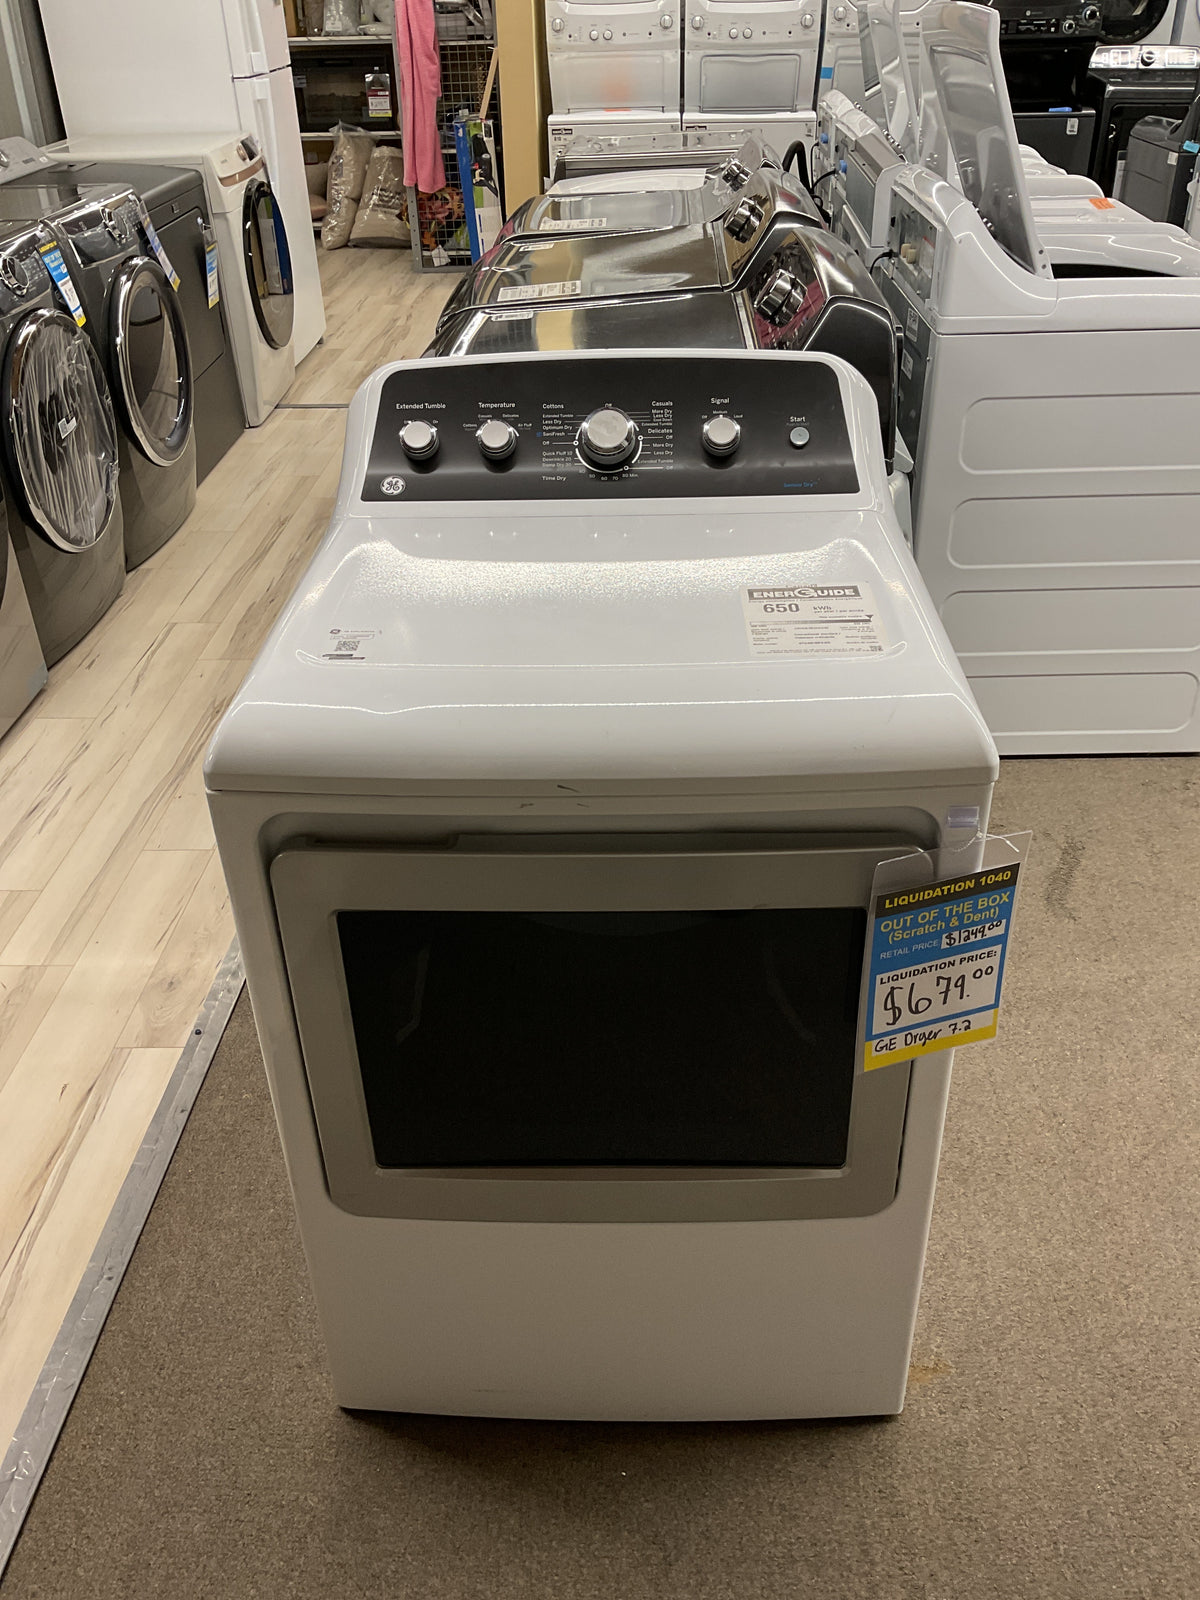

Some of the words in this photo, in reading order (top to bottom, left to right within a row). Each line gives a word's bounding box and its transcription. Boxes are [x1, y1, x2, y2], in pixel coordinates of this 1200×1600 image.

[710, 397, 730, 405] Signal
[789, 415, 806, 423] Start
[753, 587, 856, 599] ENERGUIDE
[763, 602, 801, 614] 650
[884, 879, 976, 909] LIQUIDATION
[979, 870, 1012, 886] 1040
[880, 914, 914, 933] OUT
[917, 908, 940, 924] OF
[943, 900, 974, 918] THE
[977, 891, 1011, 910] BOX
[888, 919, 946, 945] (Scratch
[949, 915, 960, 928] &
[963, 906, 999, 925] Dent)
[880, 947, 910, 960] RETAIL
[880, 959, 956, 986] LIQUIDATION
[959, 949, 998, 966] PRICE:
[874, 1036, 898, 1053] GE
[948, 1018, 972, 1035] 7.2
